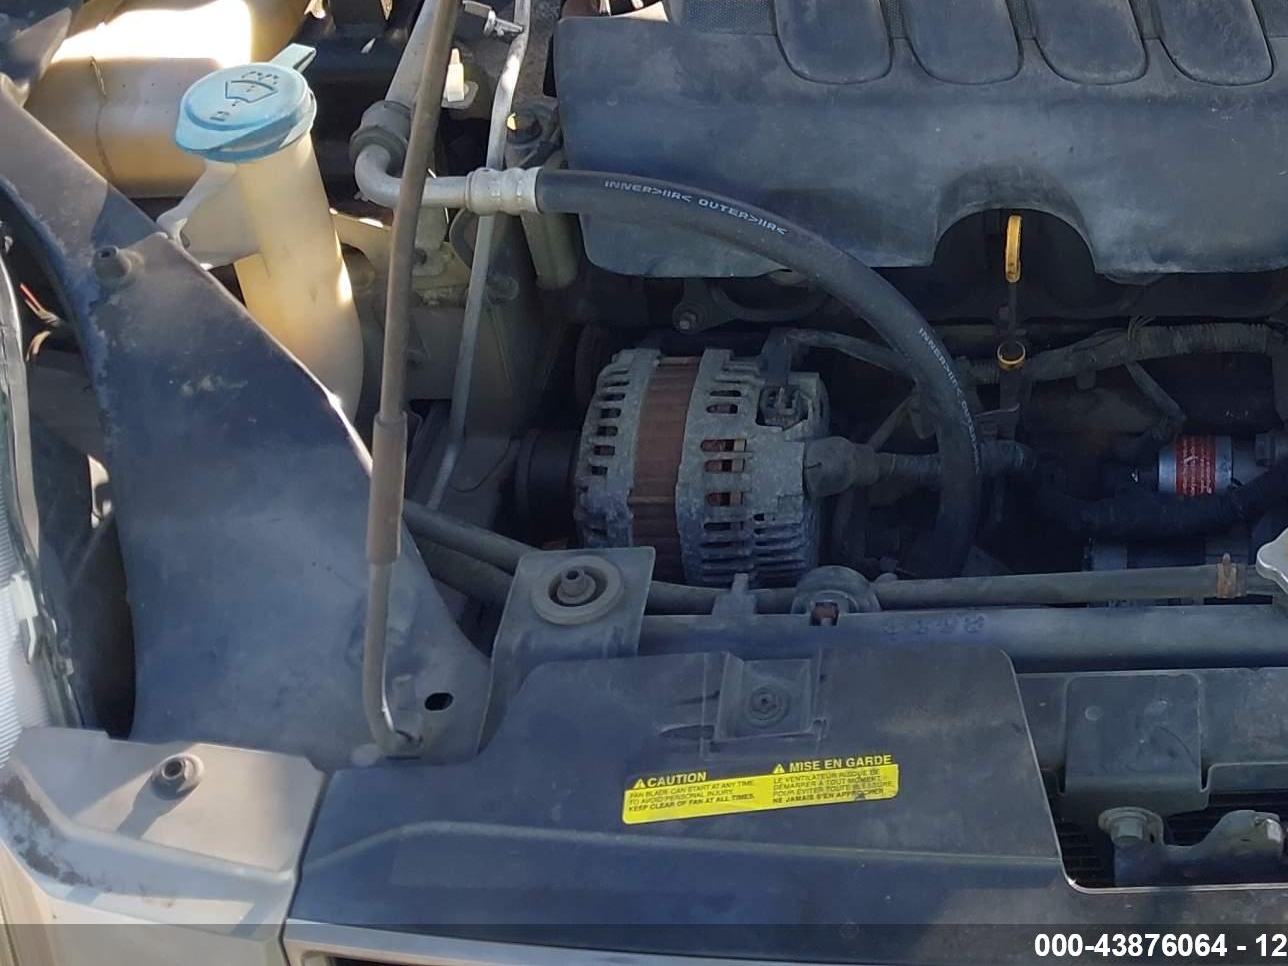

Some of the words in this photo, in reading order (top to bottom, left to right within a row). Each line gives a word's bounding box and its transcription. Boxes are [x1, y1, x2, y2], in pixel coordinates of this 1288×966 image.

[789, 761, 821, 773] MISE
[824, 758, 842, 770] EN
[845, 754, 892, 767] GARDE
[647, 771, 707, 788] CAUTION
[670, 787, 687, 795] CAN
[628, 804, 649, 812] KEEP
[649, 801, 676, 810] CLEAR
[688, 798, 703, 806] FAN
[716, 795, 729, 803] ALL
